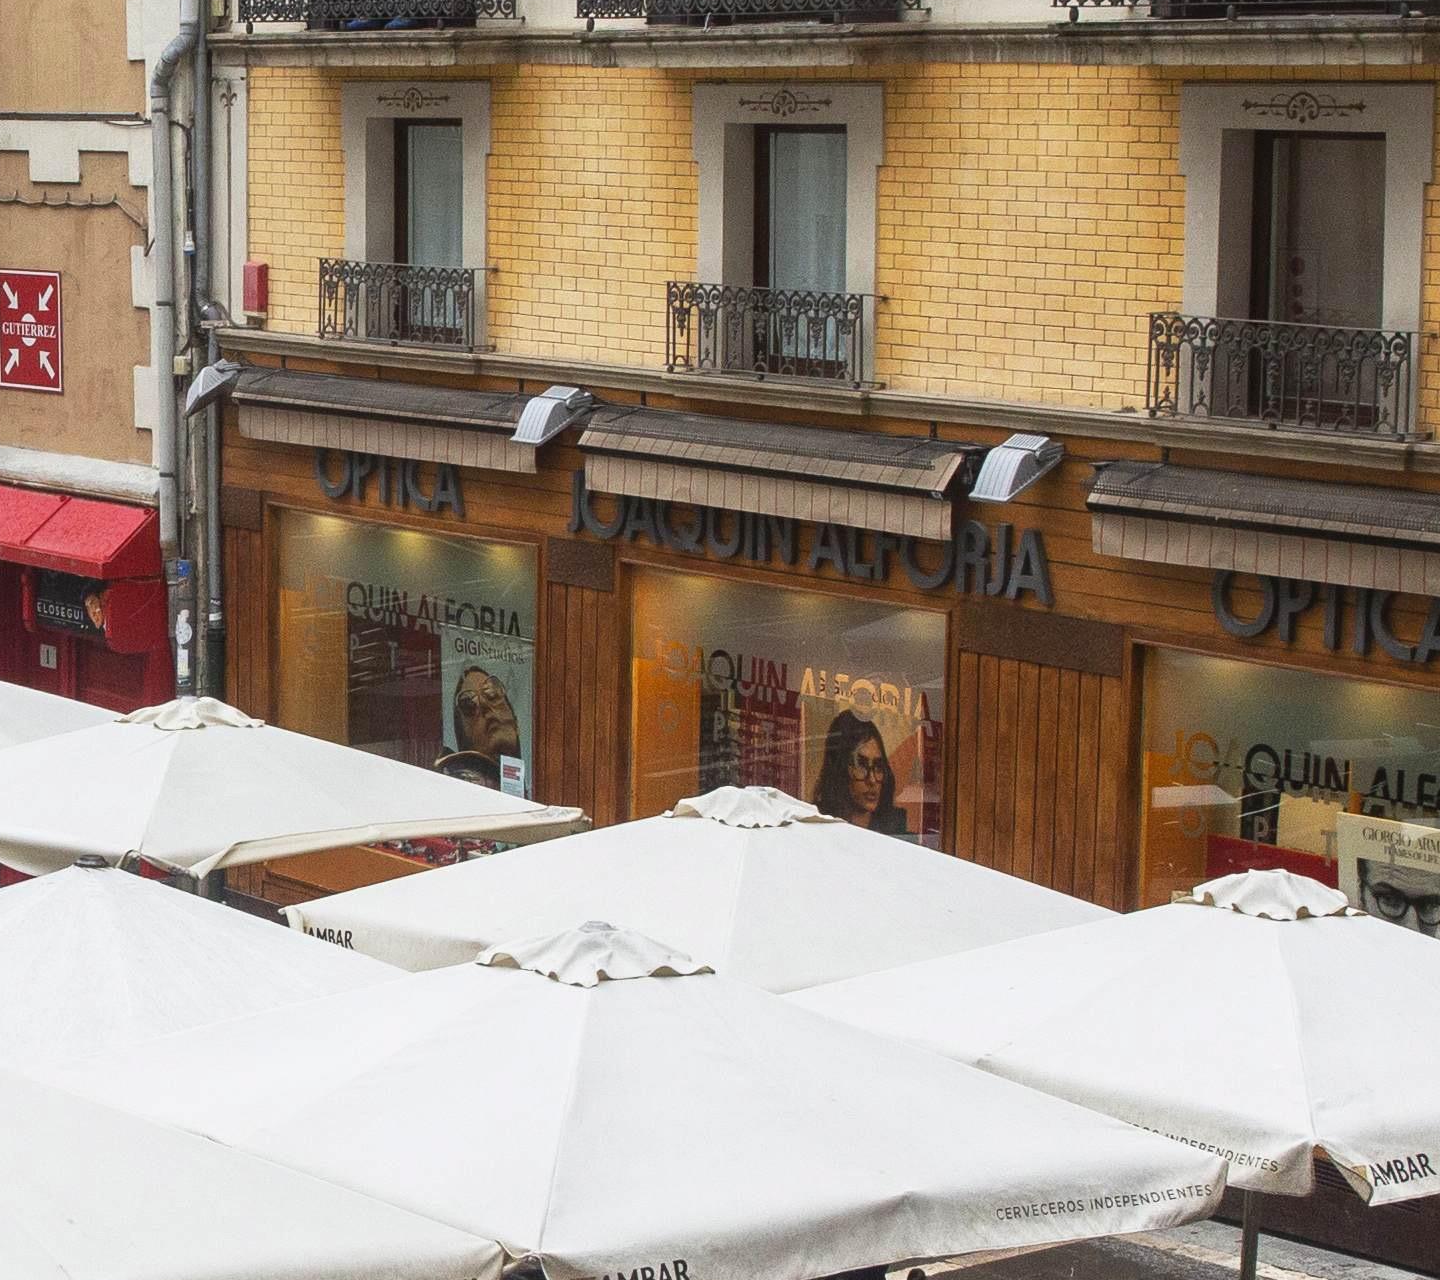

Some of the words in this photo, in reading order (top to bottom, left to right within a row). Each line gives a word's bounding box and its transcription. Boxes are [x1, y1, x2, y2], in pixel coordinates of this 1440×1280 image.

[2, 322, 56, 338] GUTIERREZ
[566, 469, 799, 566] JOAQUIN
[806, 518, 1055, 607] ALFORJA
[36, 601, 84, 621] ELOSEGUI
[1362, 826, 1413, 849] GIORGIO
[1370, 1153, 1438, 1187] AMBAR
[996, 1199, 1085, 1221] CERVECEROS
[1090, 1183, 1212, 1210] INDEPENDIENTES
